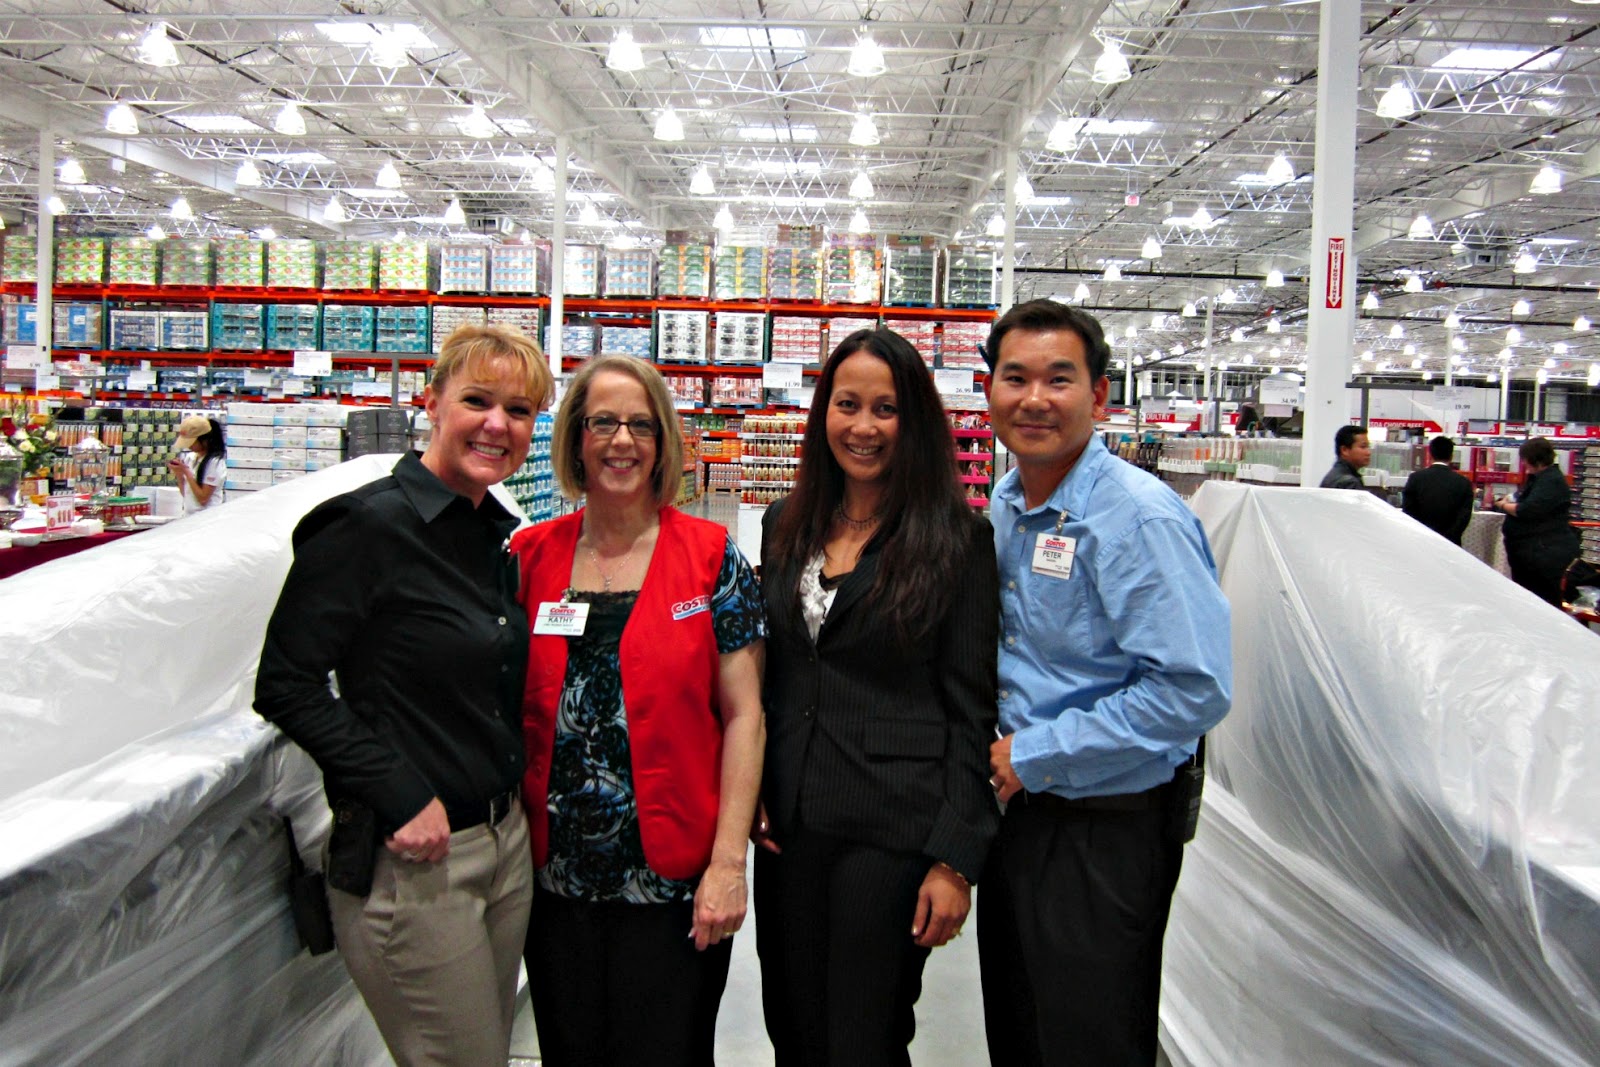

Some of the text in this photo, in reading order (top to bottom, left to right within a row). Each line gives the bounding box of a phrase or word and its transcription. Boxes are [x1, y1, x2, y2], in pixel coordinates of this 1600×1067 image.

[1330, 243, 1343, 251] FIRE
[1145, 412, 1171, 420] OULTRY
[1045, 539, 1066, 548] COSTCO
[1042, 550, 1062, 560] PETER
